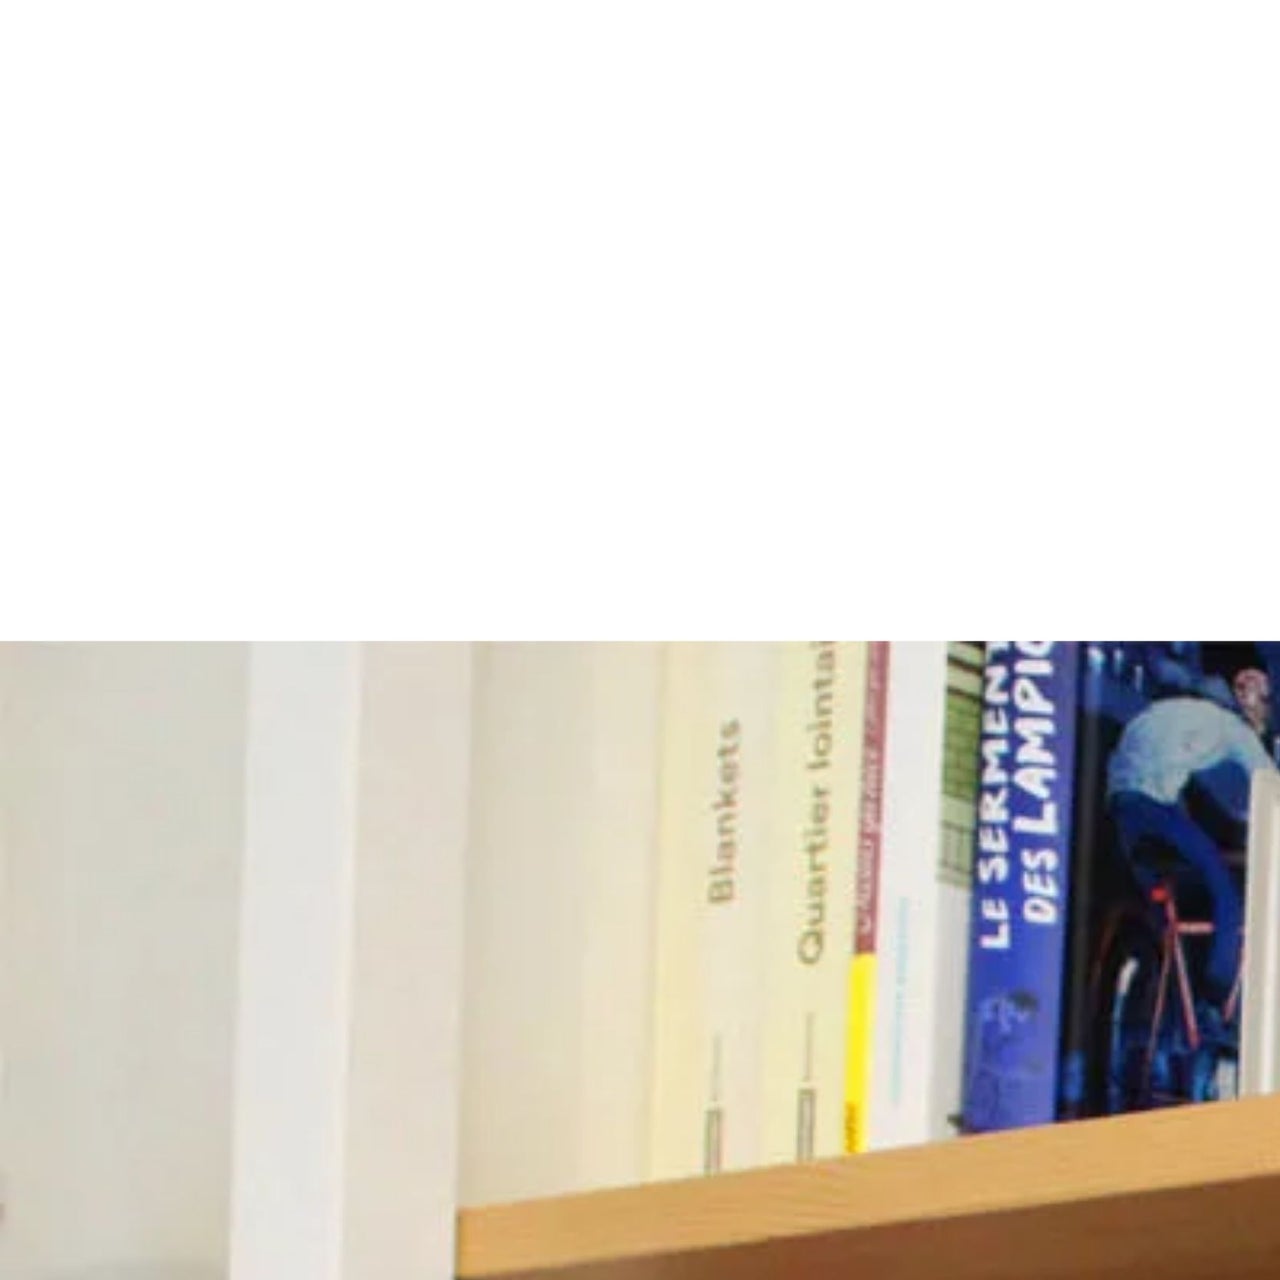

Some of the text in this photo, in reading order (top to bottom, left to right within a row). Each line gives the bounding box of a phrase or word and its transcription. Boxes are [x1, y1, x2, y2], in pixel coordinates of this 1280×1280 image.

[706, 718, 742, 904] Blankets
[797, 785, 832, 966] Quartier
[978, 898, 1011, 950] LE
[1021, 846, 1057, 924] DES
